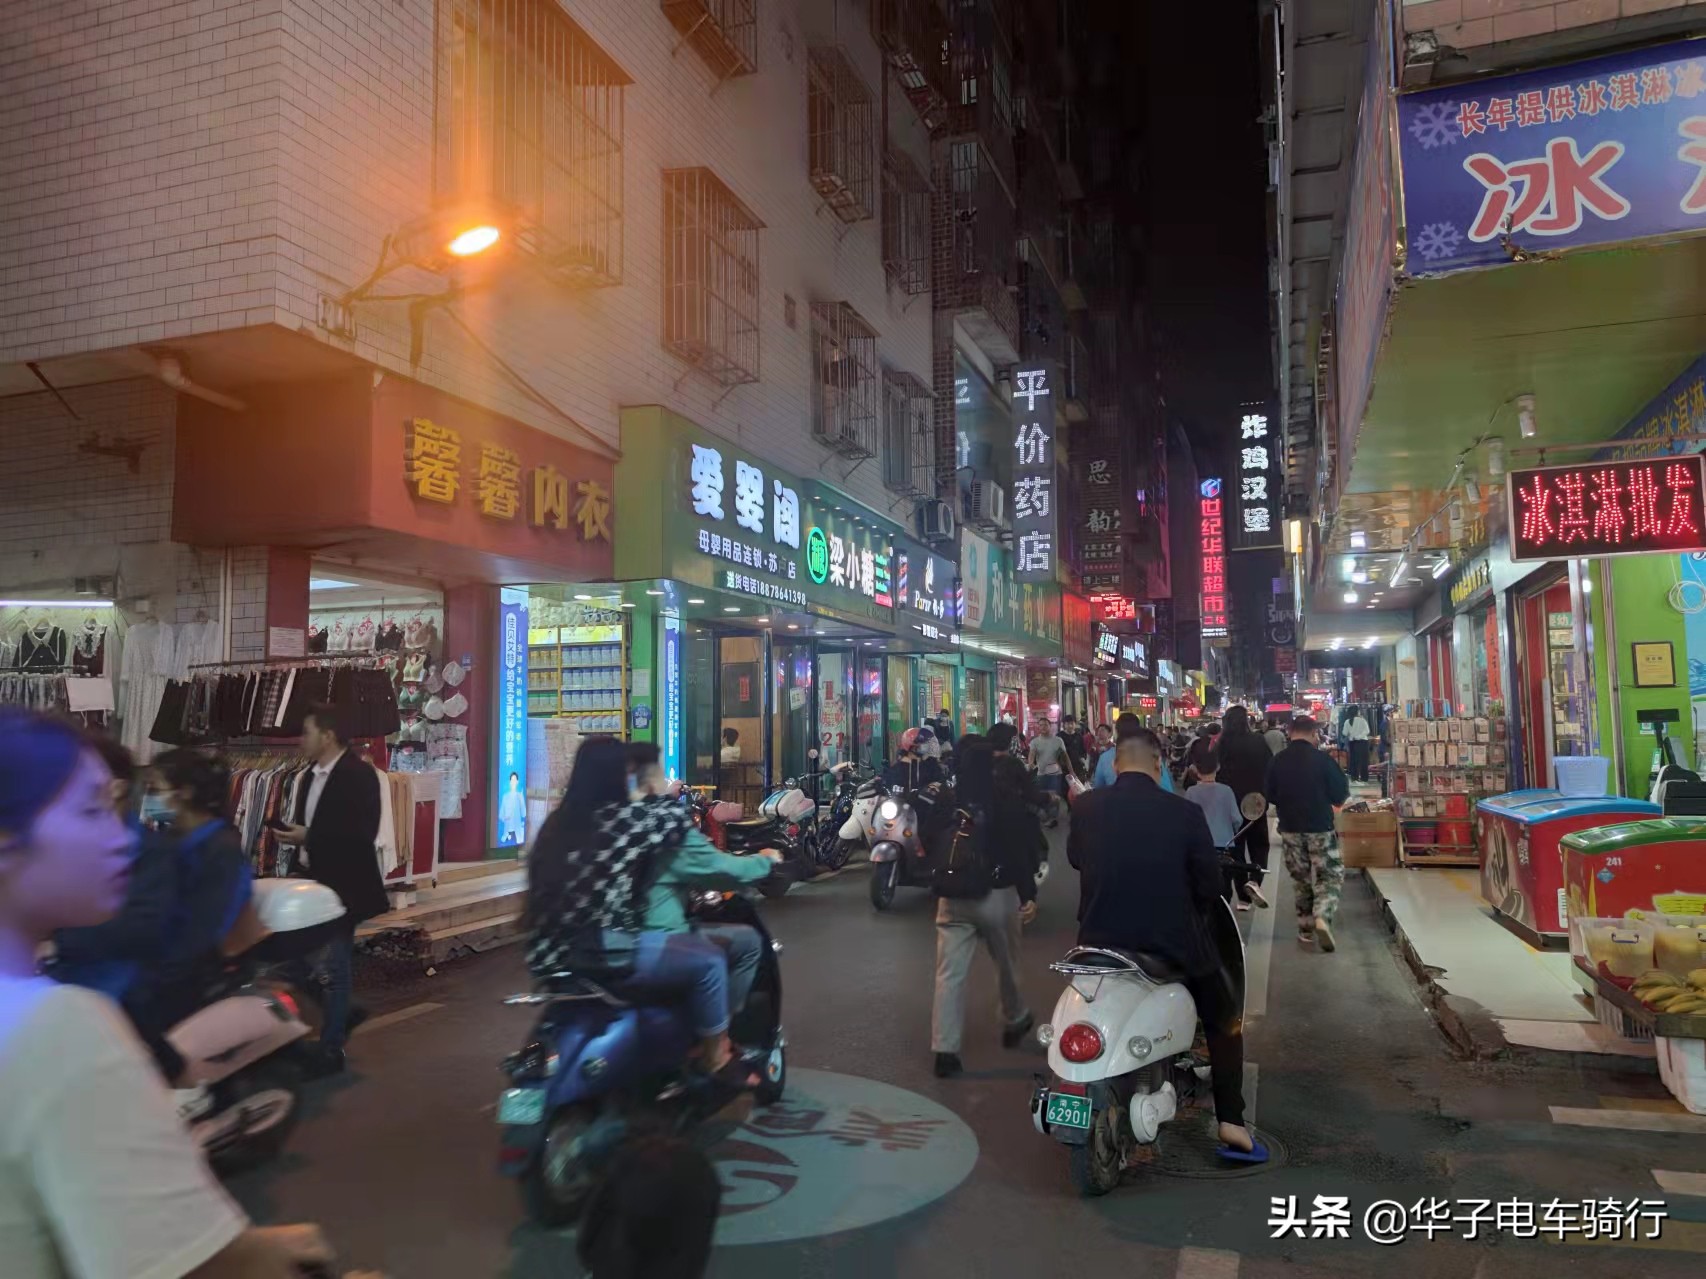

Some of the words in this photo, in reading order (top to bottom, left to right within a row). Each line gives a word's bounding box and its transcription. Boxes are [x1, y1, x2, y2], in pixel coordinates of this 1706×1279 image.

[412, 416, 610, 542] 馨馨内衣
[691, 443, 799, 549] 爱婴阁
[1014, 369, 1050, 571] 平价药店
[1241, 414, 1270, 532] 炸鸡汉堡
[1519, 464, 1698, 545] 冰淇淋批发
[1201, 498, 1224, 612] 世纪华联超市
[1048, 1106, 1087, 1125] 62901
